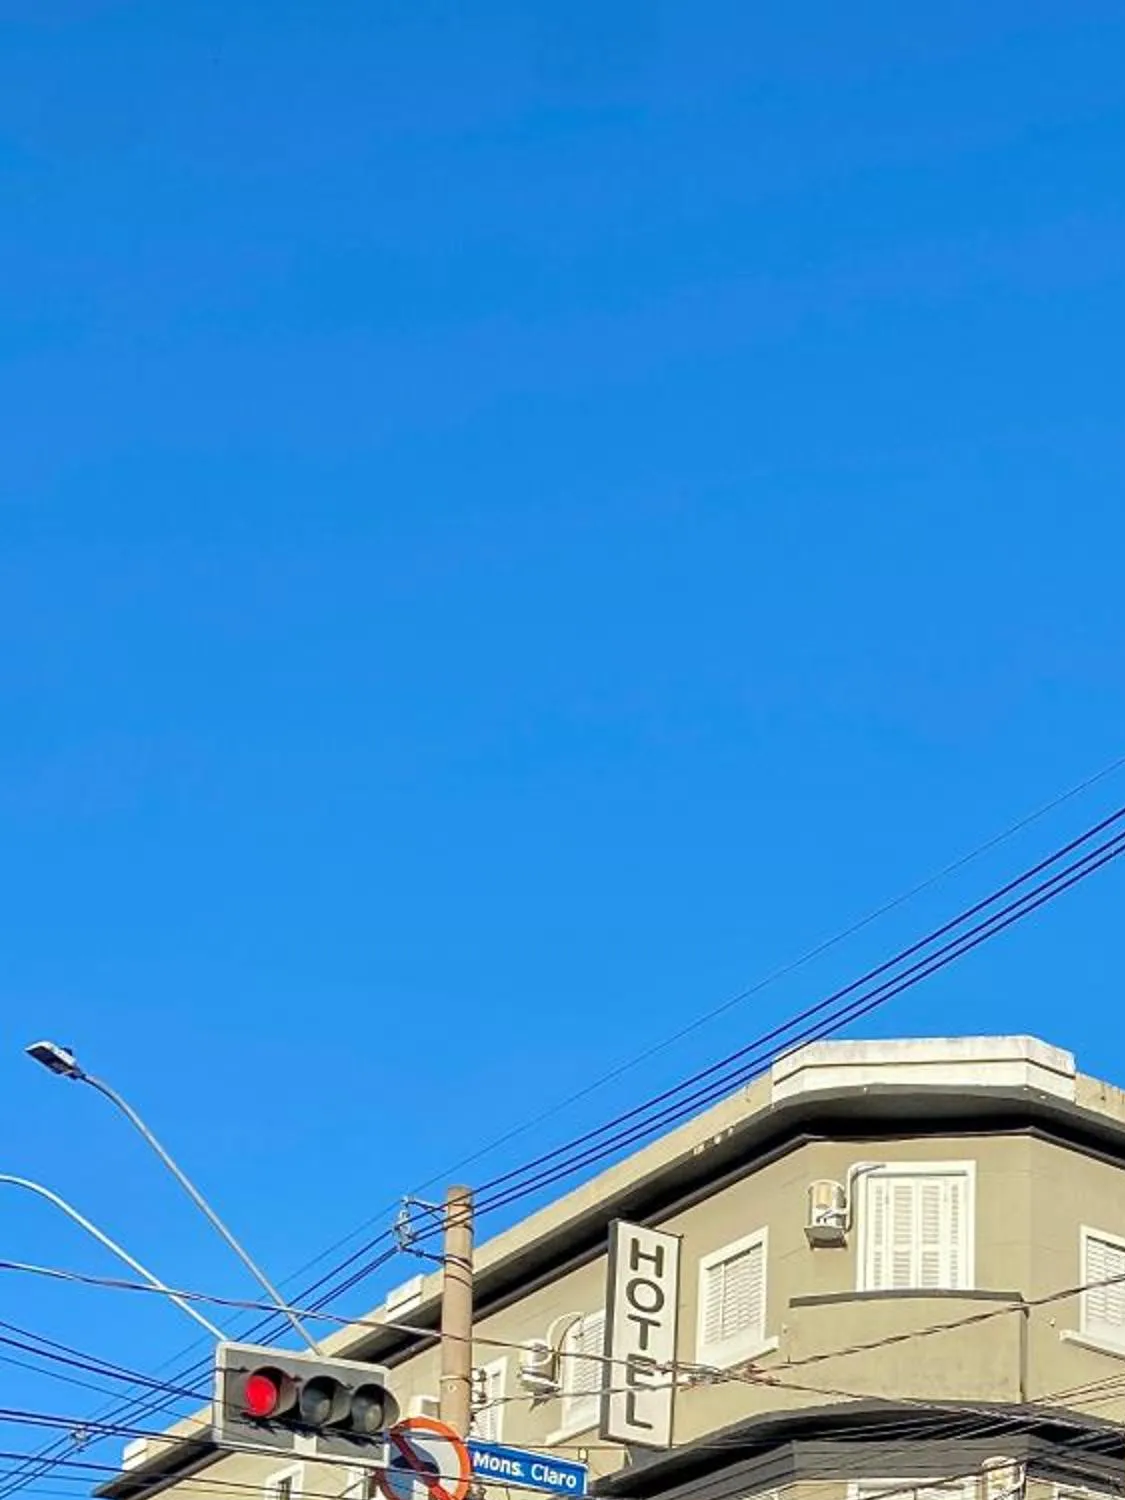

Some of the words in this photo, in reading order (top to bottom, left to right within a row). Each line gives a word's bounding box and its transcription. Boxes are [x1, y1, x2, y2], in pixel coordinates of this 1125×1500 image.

[625, 1237, 665, 1430] HOTEL
[473, 1451, 524, 1477] Mons.
[531, 1463, 577, 1488] Claro
